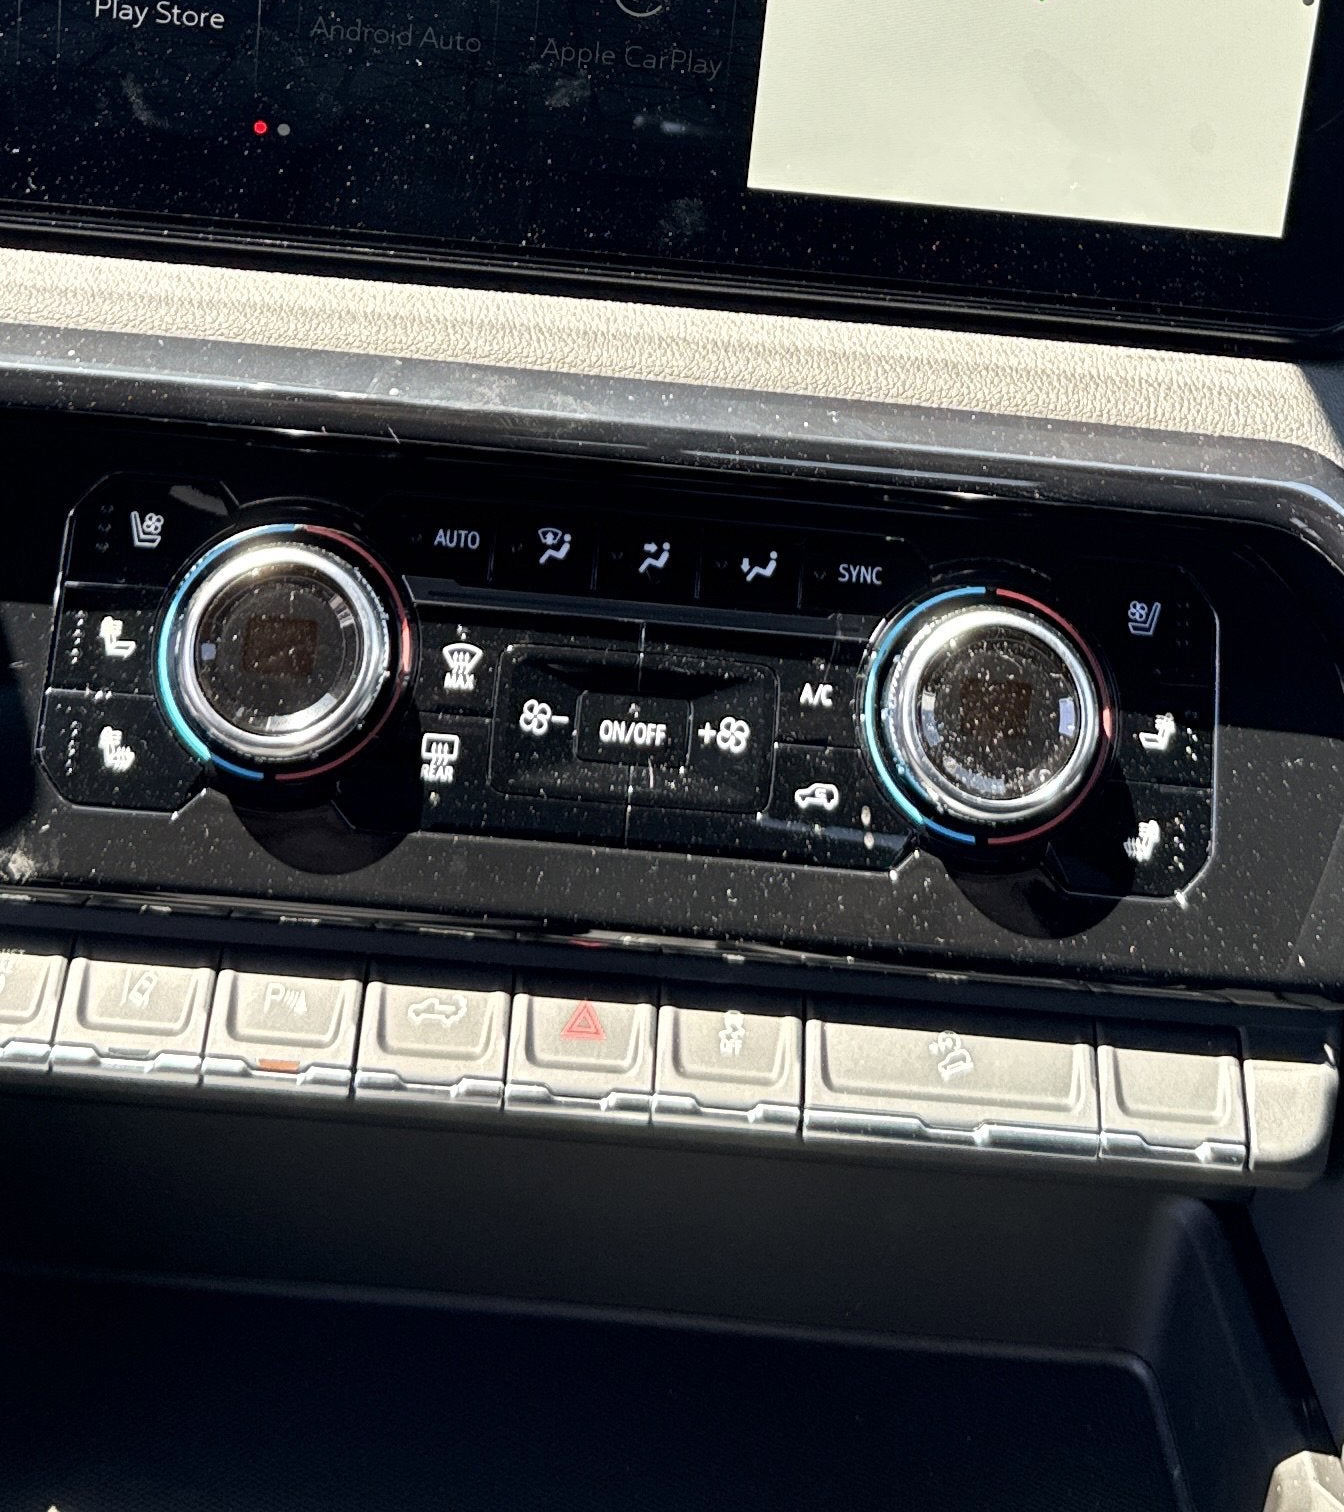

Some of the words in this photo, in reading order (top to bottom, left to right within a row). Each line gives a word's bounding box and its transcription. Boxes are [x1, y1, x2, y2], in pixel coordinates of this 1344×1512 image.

[156, 0, 226, 29] Store
[309, 16, 413, 47] Android
[419, 26, 482, 53] Auto
[540, 39, 616, 68] Apple
[624, 45, 723, 82] CarPlay
[433, 528, 480, 549] AUTO
[837, 563, 883, 585] SYNC
[443, 671, 475, 690] MAX
[799, 682, 833, 707] A/C
[599, 719, 667, 746] ON/OFF
[420, 763, 454, 782] REAR
